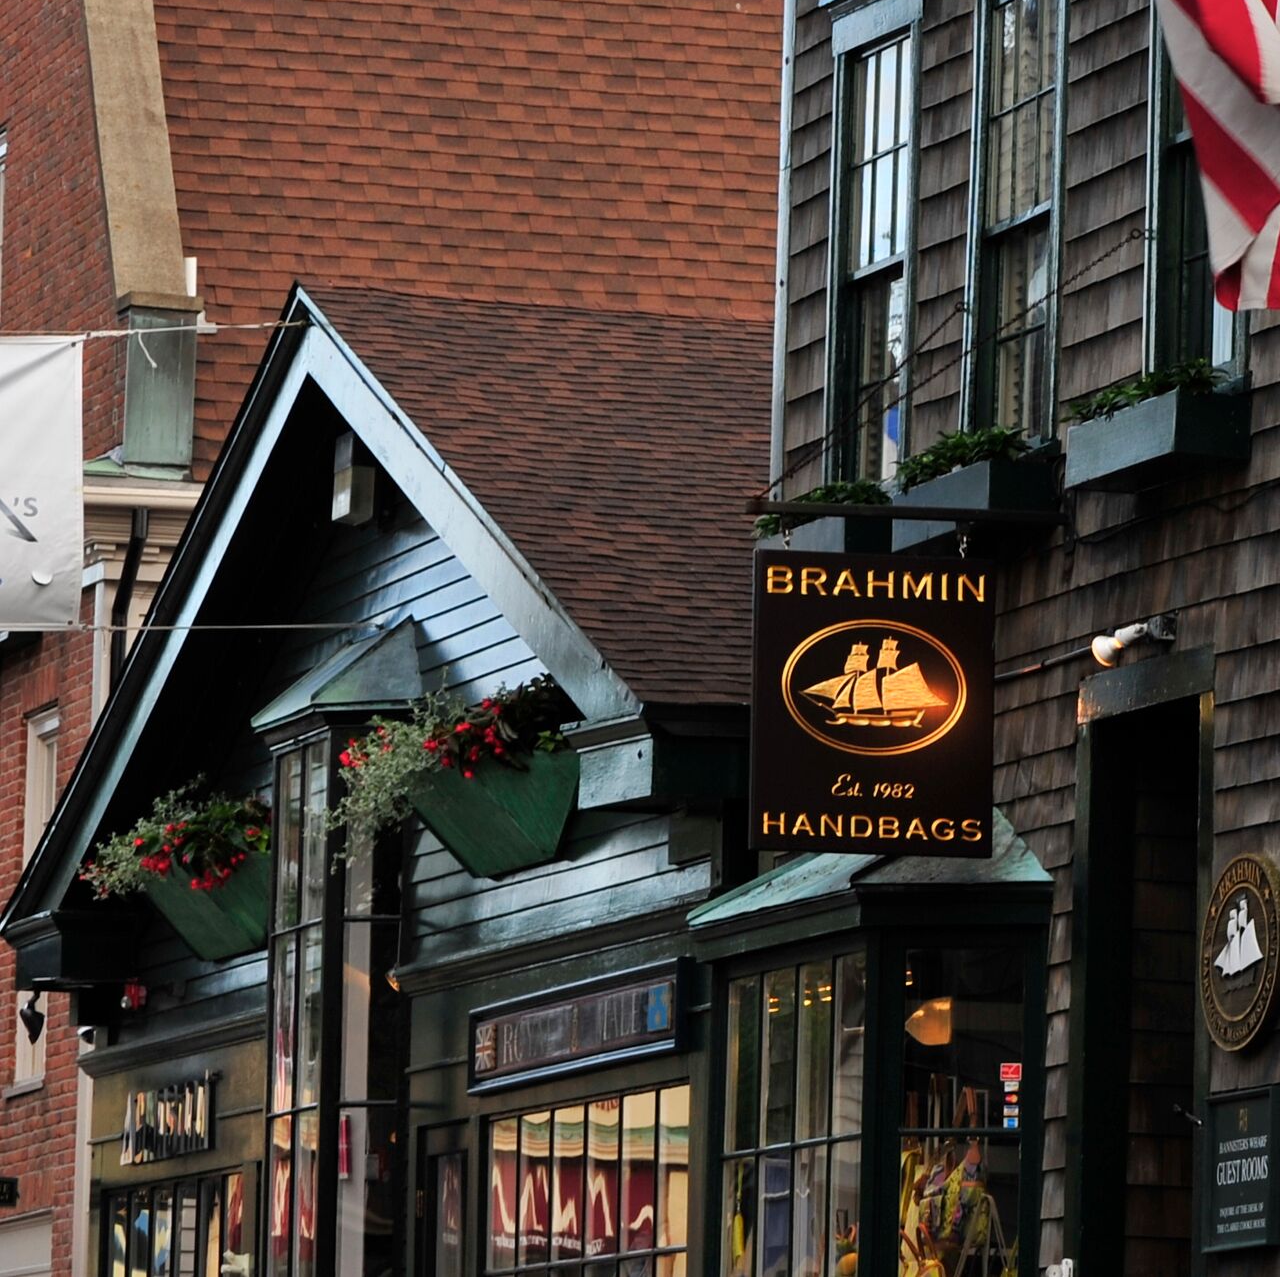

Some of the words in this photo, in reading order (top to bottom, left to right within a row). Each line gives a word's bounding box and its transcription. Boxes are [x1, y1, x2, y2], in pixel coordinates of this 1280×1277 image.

[766, 565, 985, 603] BRAHMIN
[831, 773, 863, 797] Est.
[873, 782, 915, 799] 1982
[762, 812, 983, 842] HANDBAGS
[1219, 861, 1261, 900] BRAHMIN
[1249, 1135, 1268, 1149] WHARF
[1217, 1160, 1241, 1186] GUEST
[1241, 1155, 1269, 1182] ROOMS
